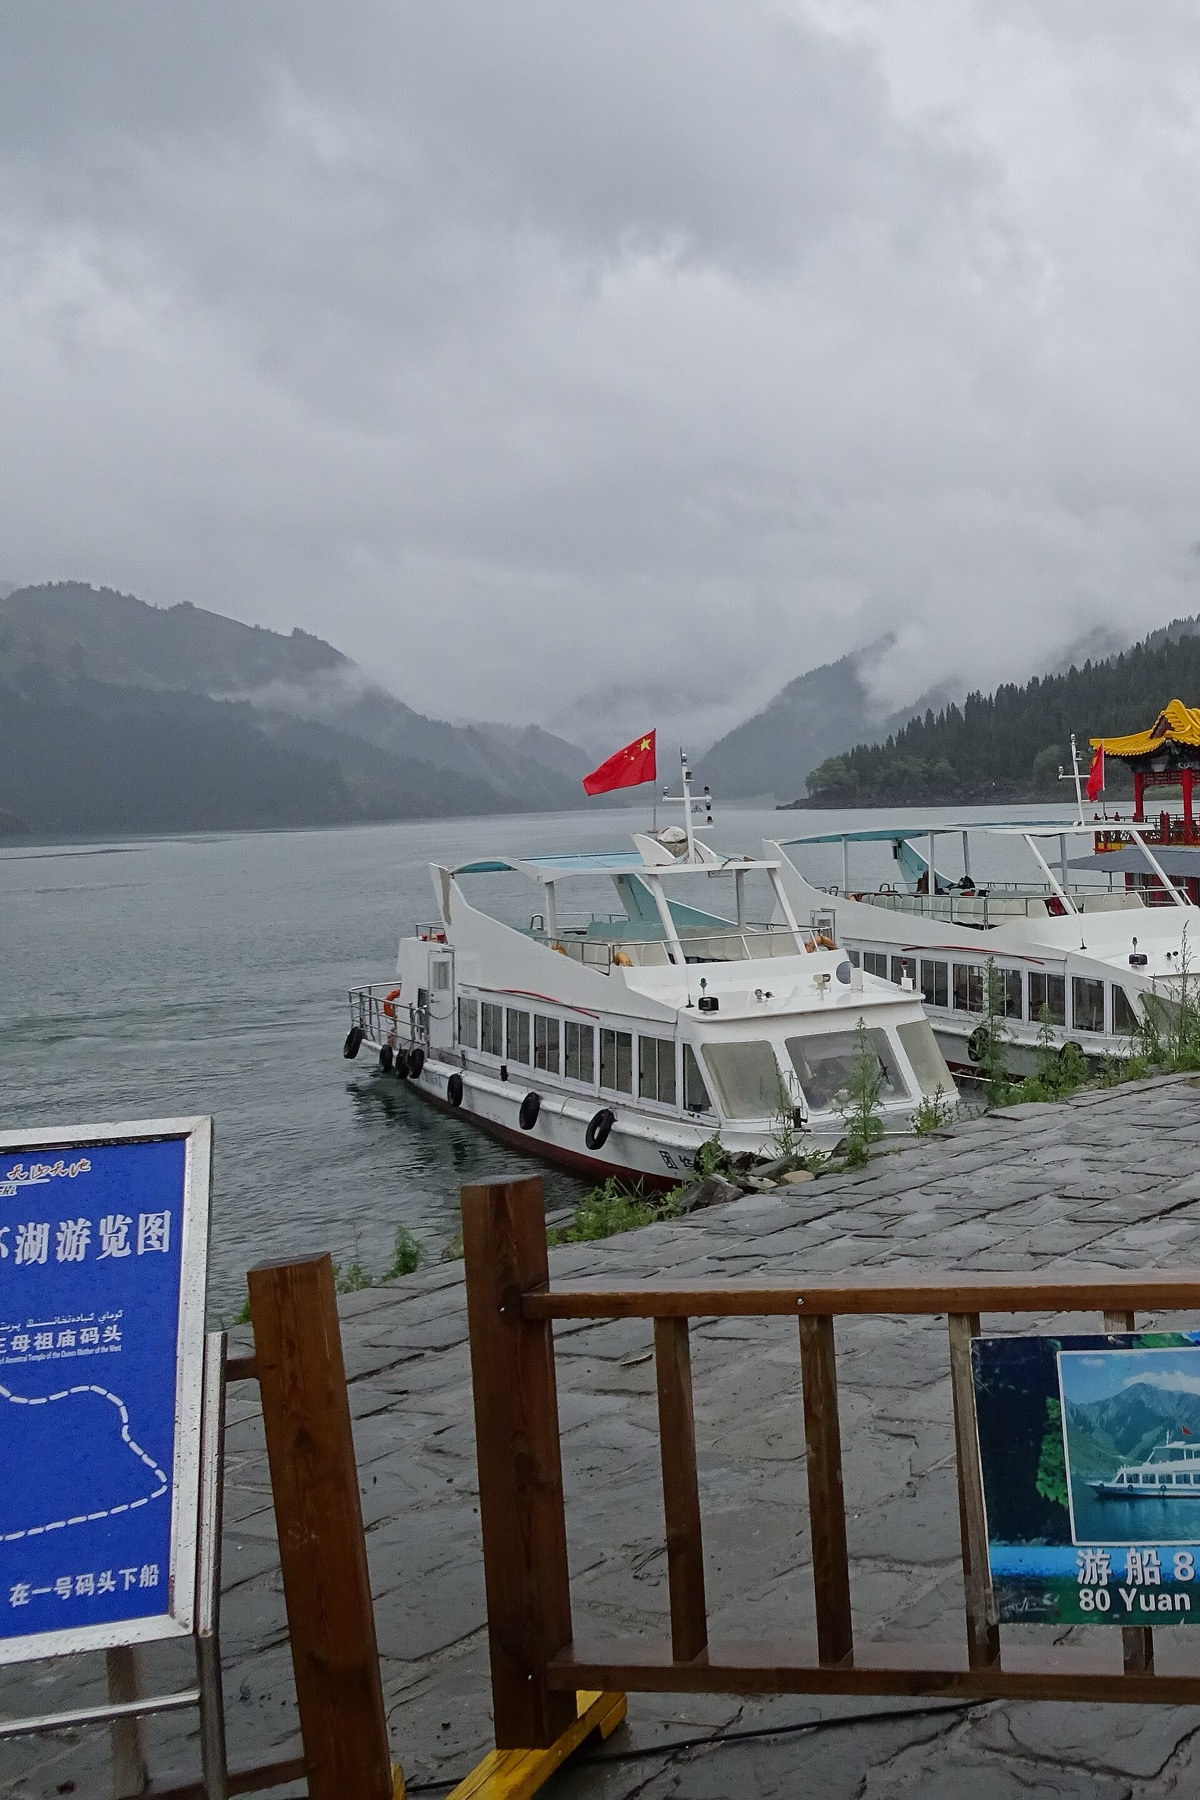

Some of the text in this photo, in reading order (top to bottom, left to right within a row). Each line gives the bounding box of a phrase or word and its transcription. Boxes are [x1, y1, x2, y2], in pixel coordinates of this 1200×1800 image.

[9, 1564, 160, 1608] 在一号码头下船
[1078, 1588, 1111, 1612] 80
[1118, 1587, 1191, 1612] Yuan
